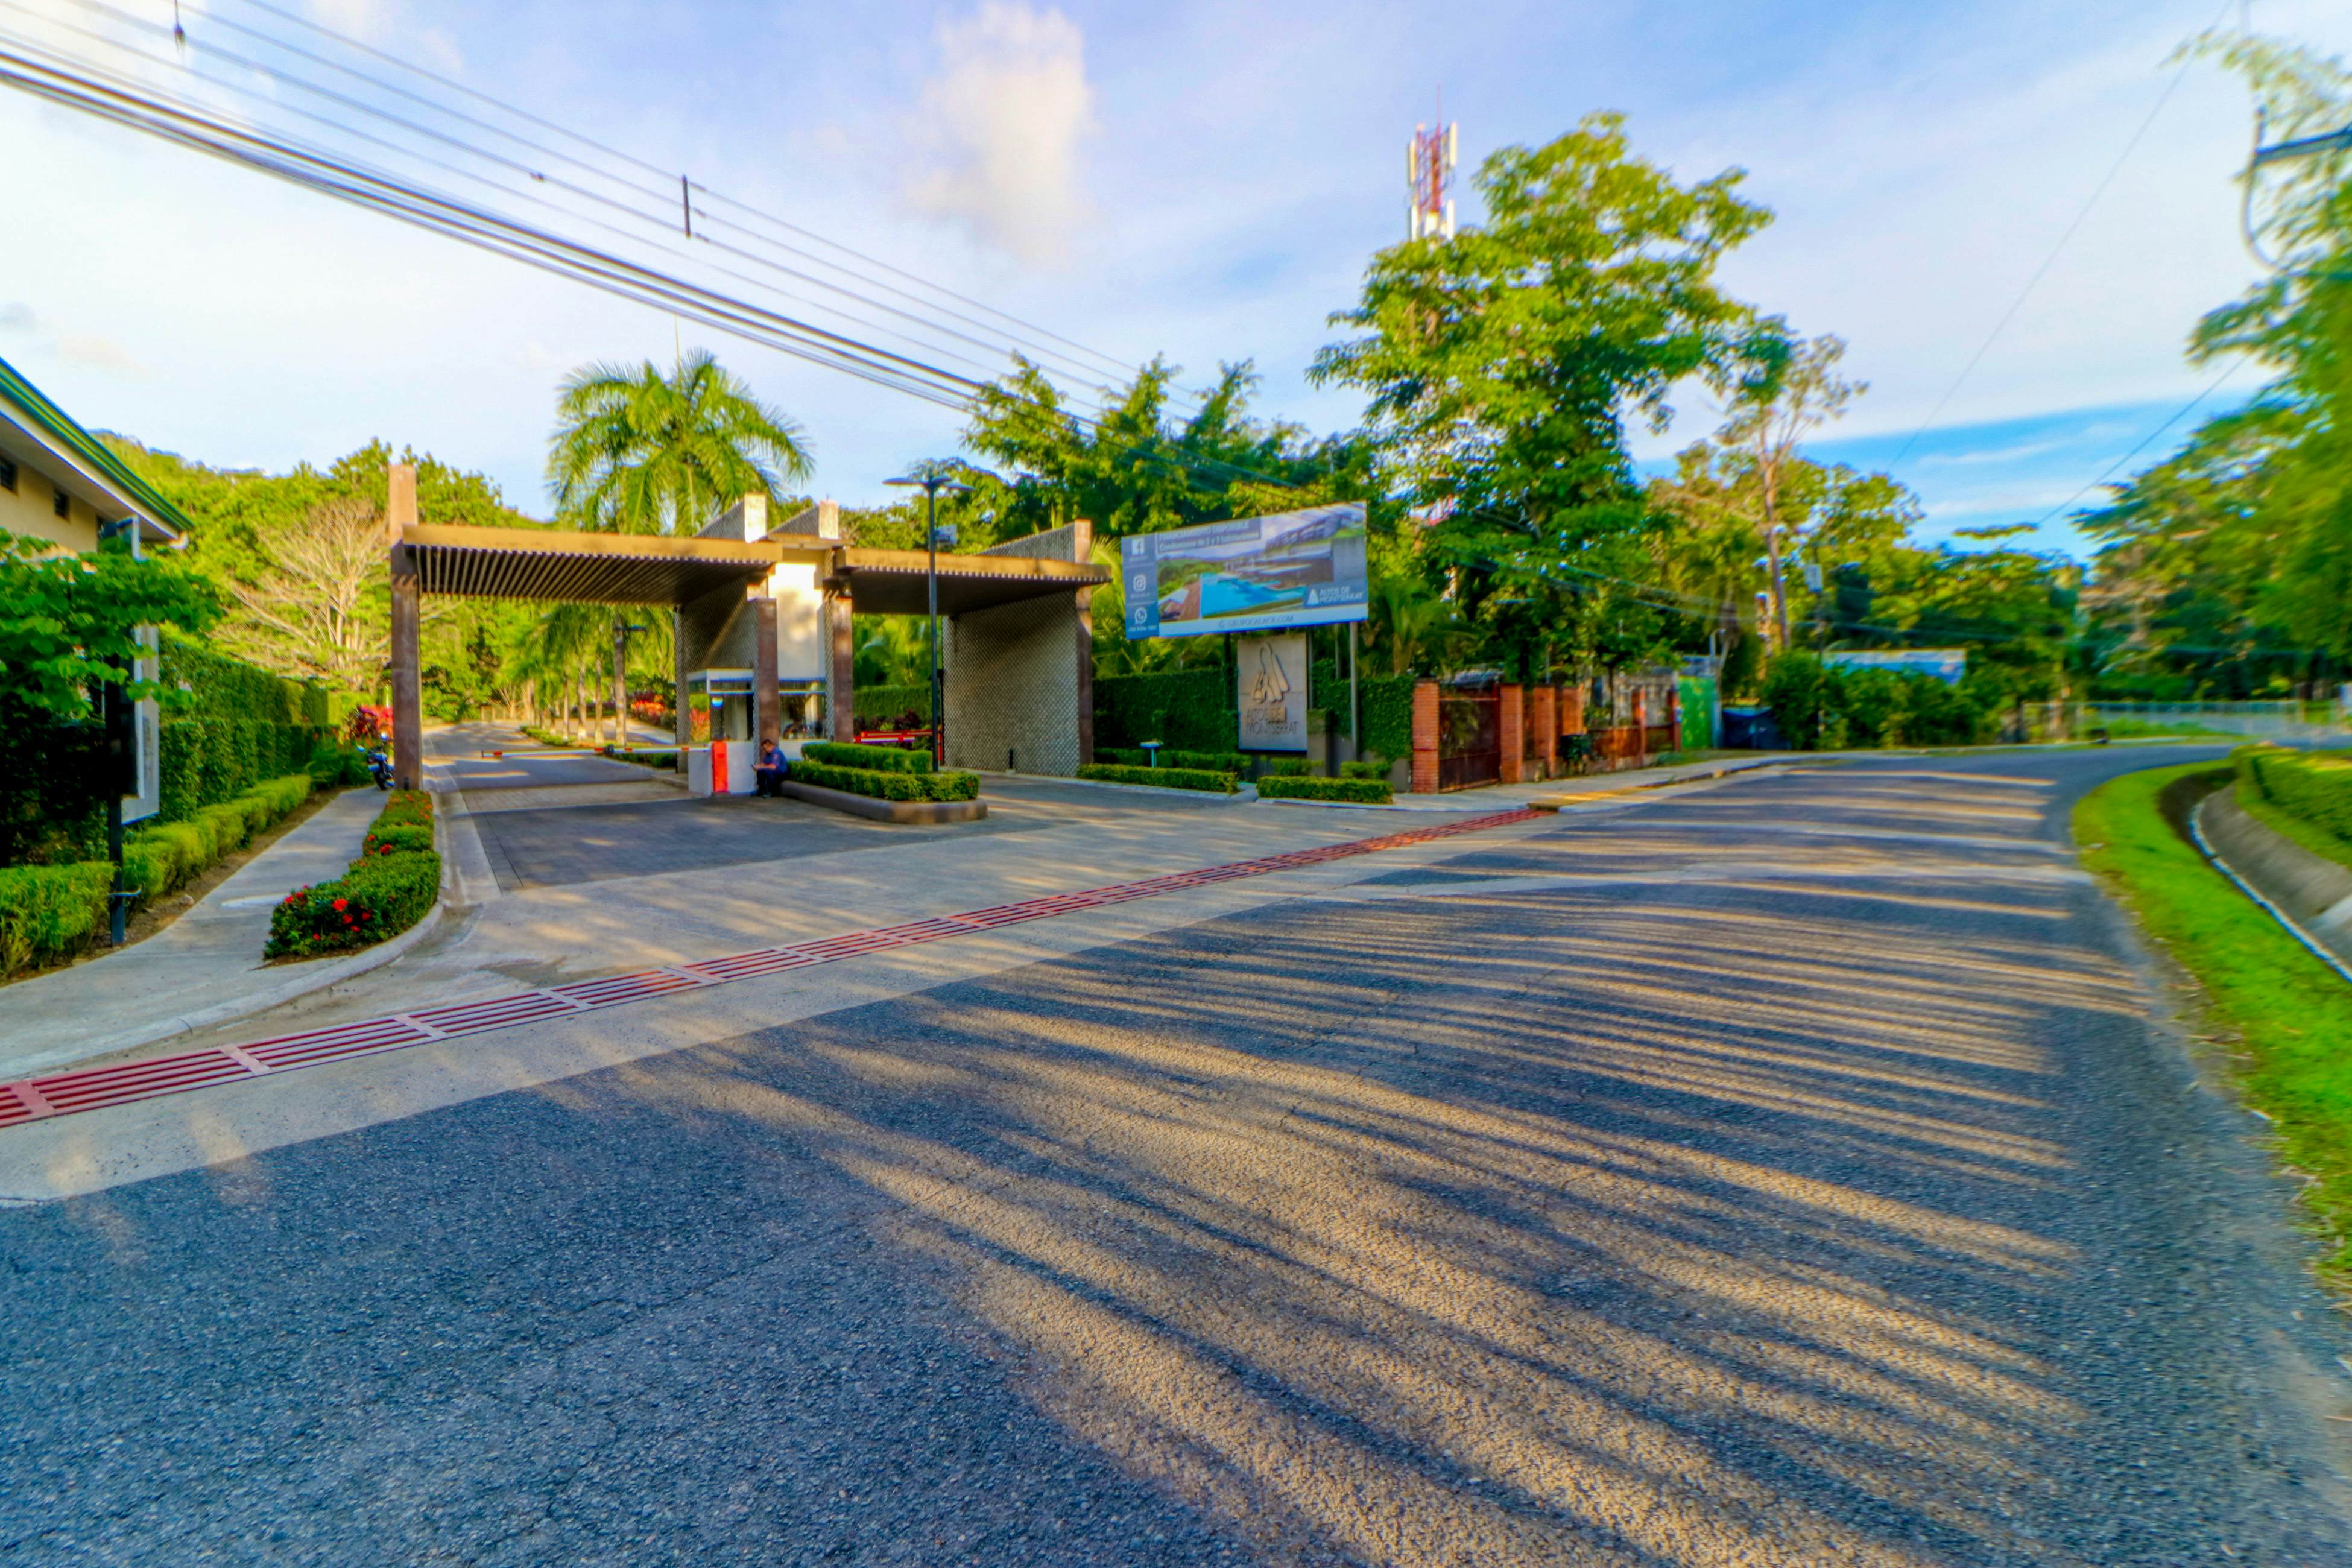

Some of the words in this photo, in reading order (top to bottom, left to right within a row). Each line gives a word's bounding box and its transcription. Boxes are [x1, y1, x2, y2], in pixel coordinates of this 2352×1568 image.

[1320, 592, 1363, 603] MONTSERRAT
[1246, 708, 1268, 721] ALTOS
[1271, 707, 1280, 720] DE
[1246, 721, 1298, 734] MONTSERRAT
